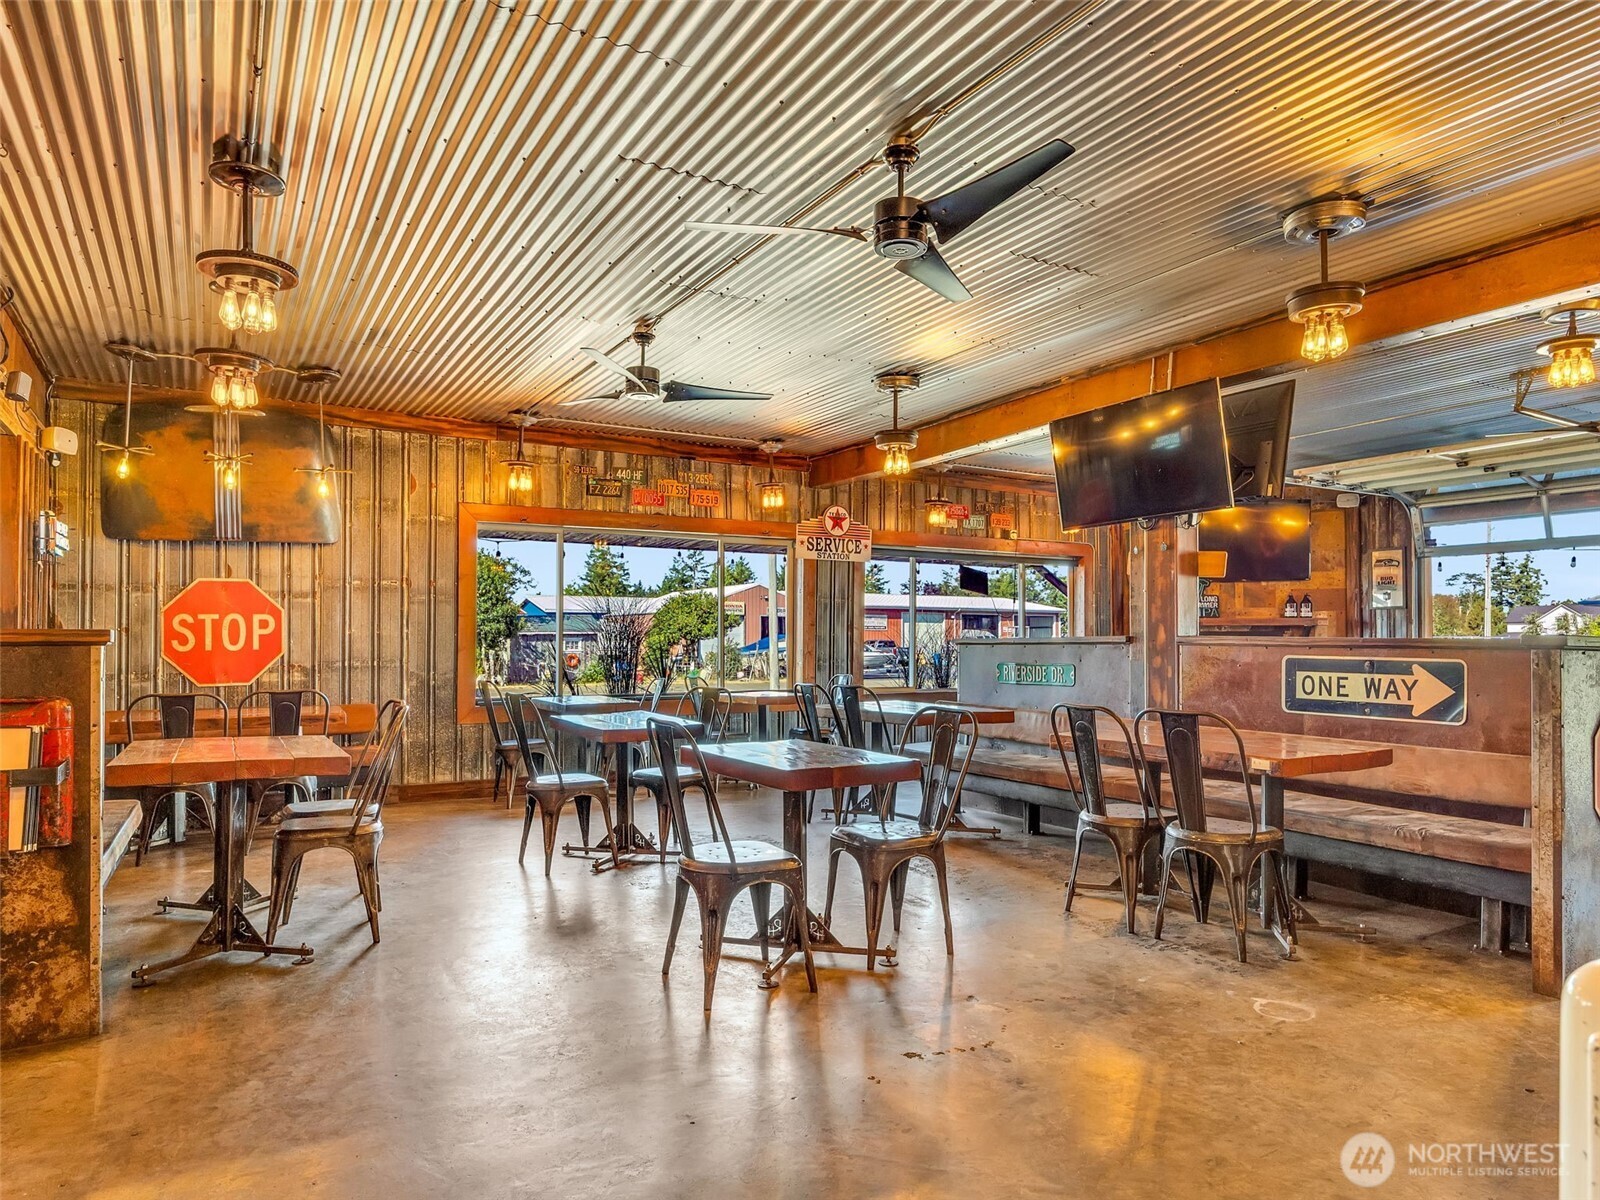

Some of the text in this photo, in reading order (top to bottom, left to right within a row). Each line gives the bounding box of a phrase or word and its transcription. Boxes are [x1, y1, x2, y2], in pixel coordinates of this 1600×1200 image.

[806, 536, 862, 555] SERVICE
[816, 552, 850, 560] STATION
[1199, 608, 1219, 617] IPA
[171, 612, 276, 652] STOP
[1003, 665, 1067, 683] RIVERSIDE DR.
[1301, 674, 1419, 701] ONE WAY
